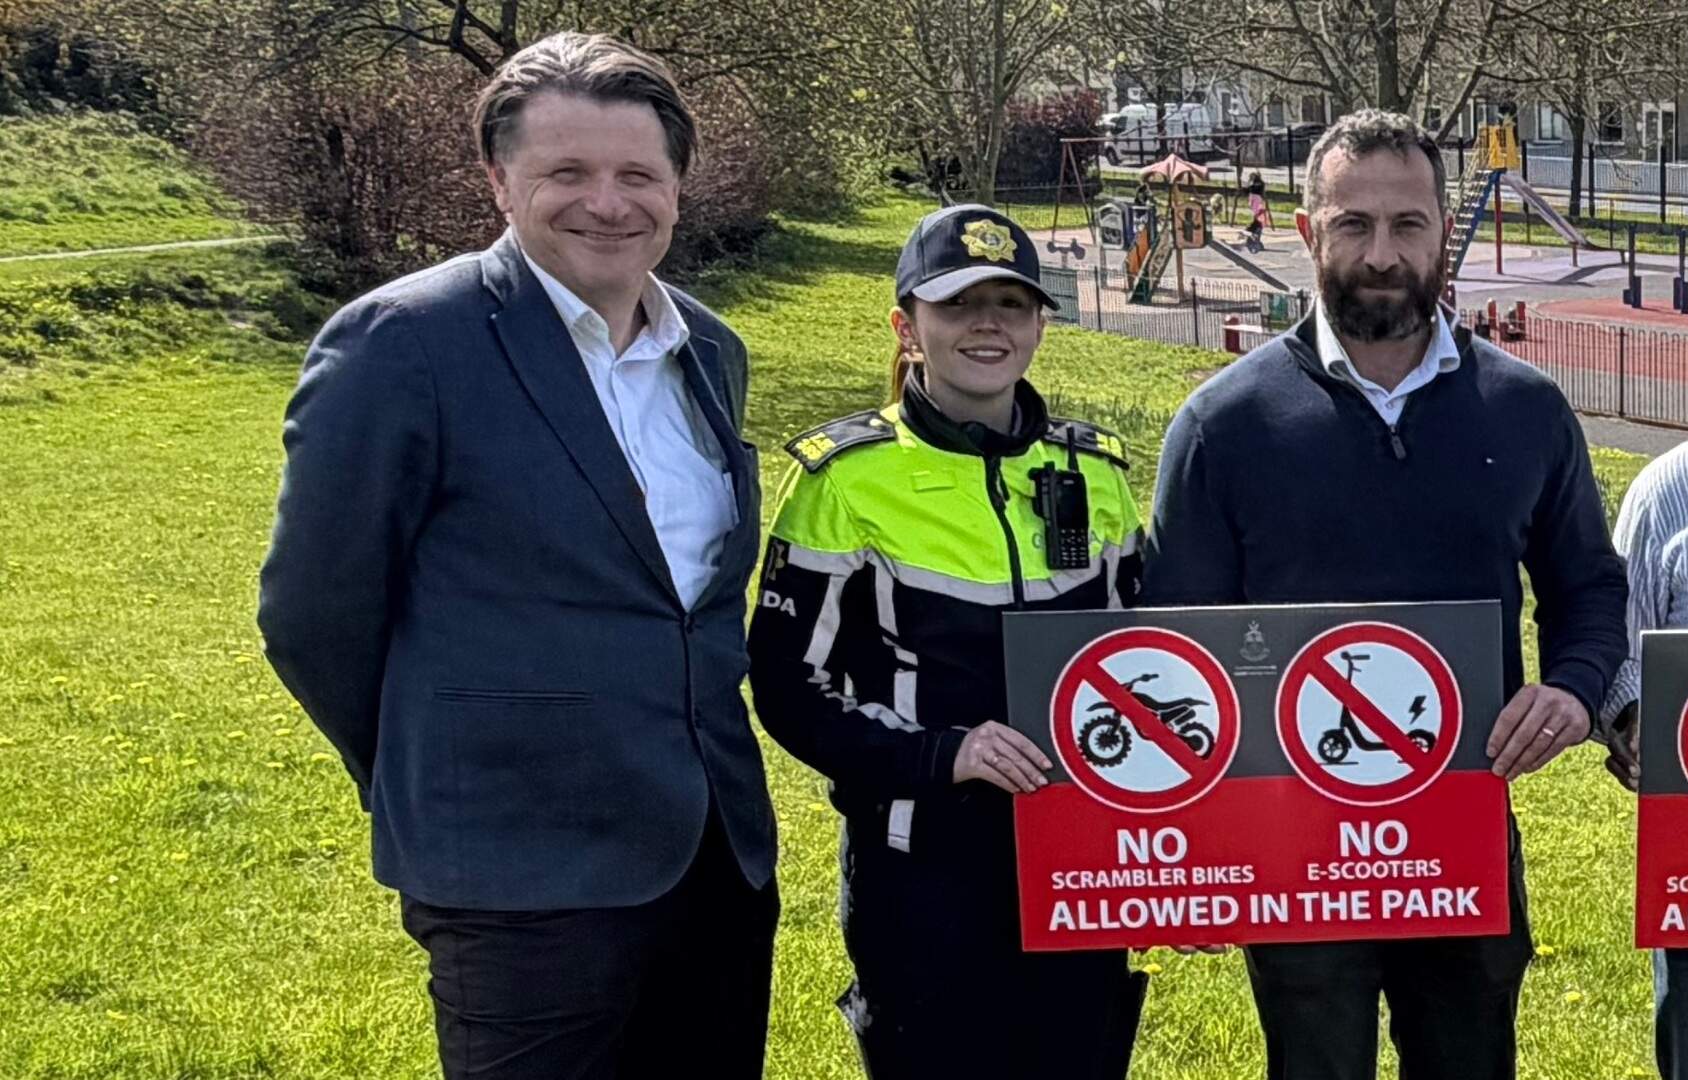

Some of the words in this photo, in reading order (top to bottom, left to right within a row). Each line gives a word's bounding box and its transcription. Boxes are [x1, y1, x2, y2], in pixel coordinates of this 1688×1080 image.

[757, 590, 797, 617] DA
[1117, 826, 1188, 865] NO
[1339, 820, 1408, 857] NO
[1051, 867, 1187, 890] SCRAMBLER
[1192, 865, 1255, 885] BIKES
[1307, 859, 1442, 881] E-SCOOTERS
[1049, 895, 1239, 931] ALLOWED
[1250, 893, 1289, 924] IN
[1296, 890, 1371, 922] THE
[1381, 886, 1481, 919] PARK
